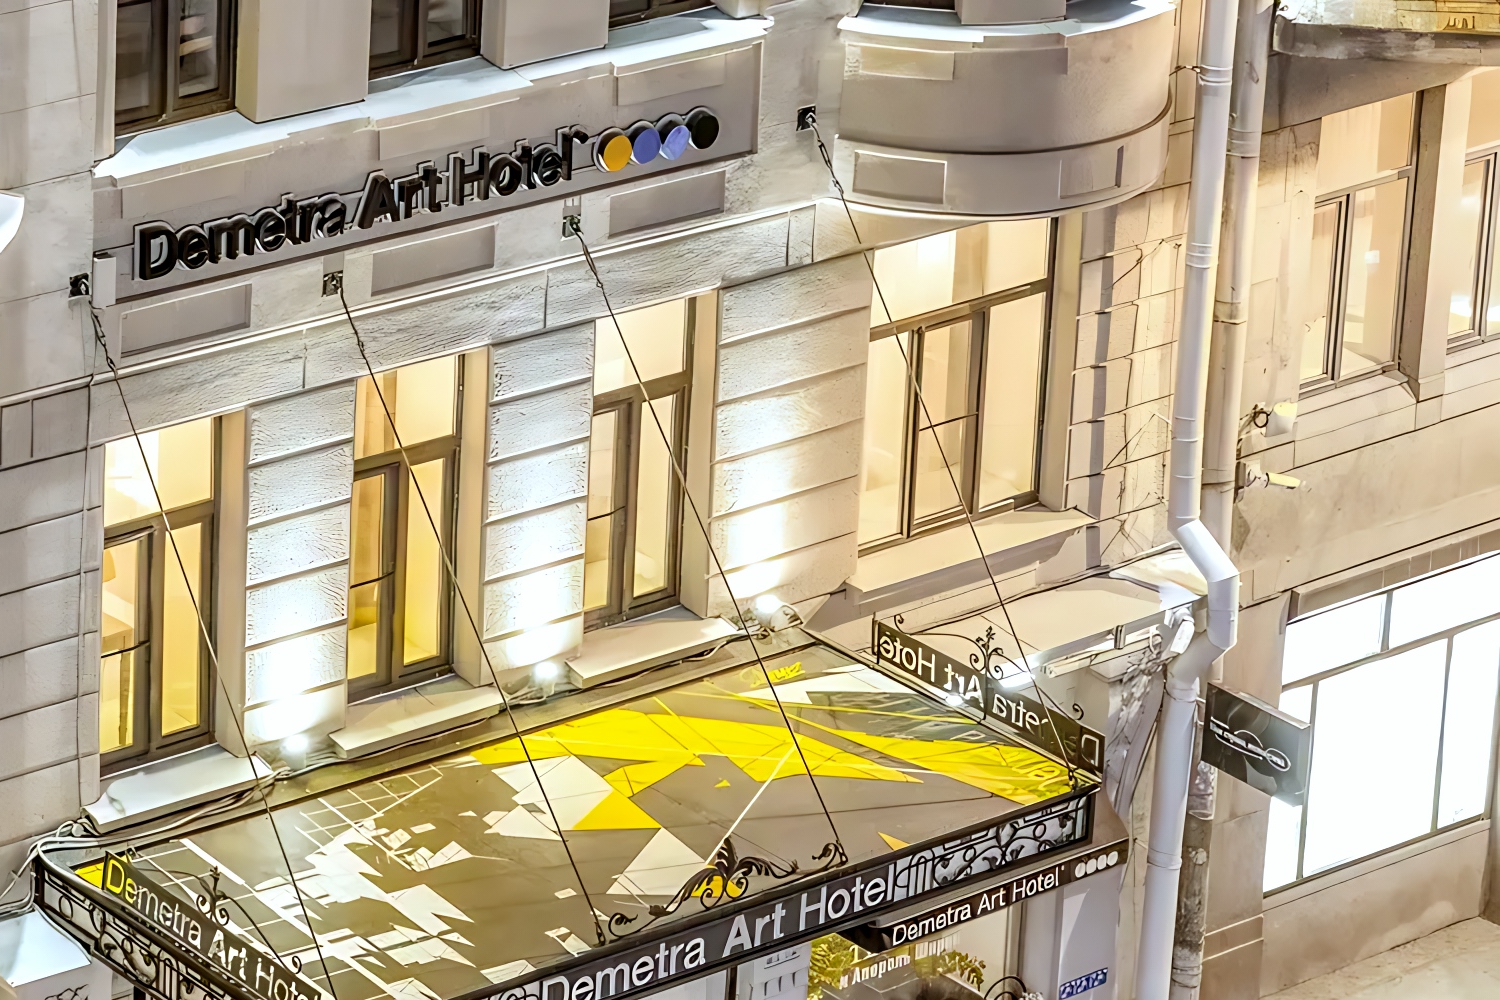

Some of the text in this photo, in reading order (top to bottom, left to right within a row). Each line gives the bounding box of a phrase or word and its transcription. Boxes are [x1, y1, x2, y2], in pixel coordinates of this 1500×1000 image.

[133, 124, 575, 281] Demetra Art Hotel
[106, 858, 201, 948] Demetra
[208, 927, 249, 981] Art
[722, 901, 787, 956] Art
[799, 862, 897, 932] Hotel
[892, 864, 1060, 946] Demetra Art Hotel
